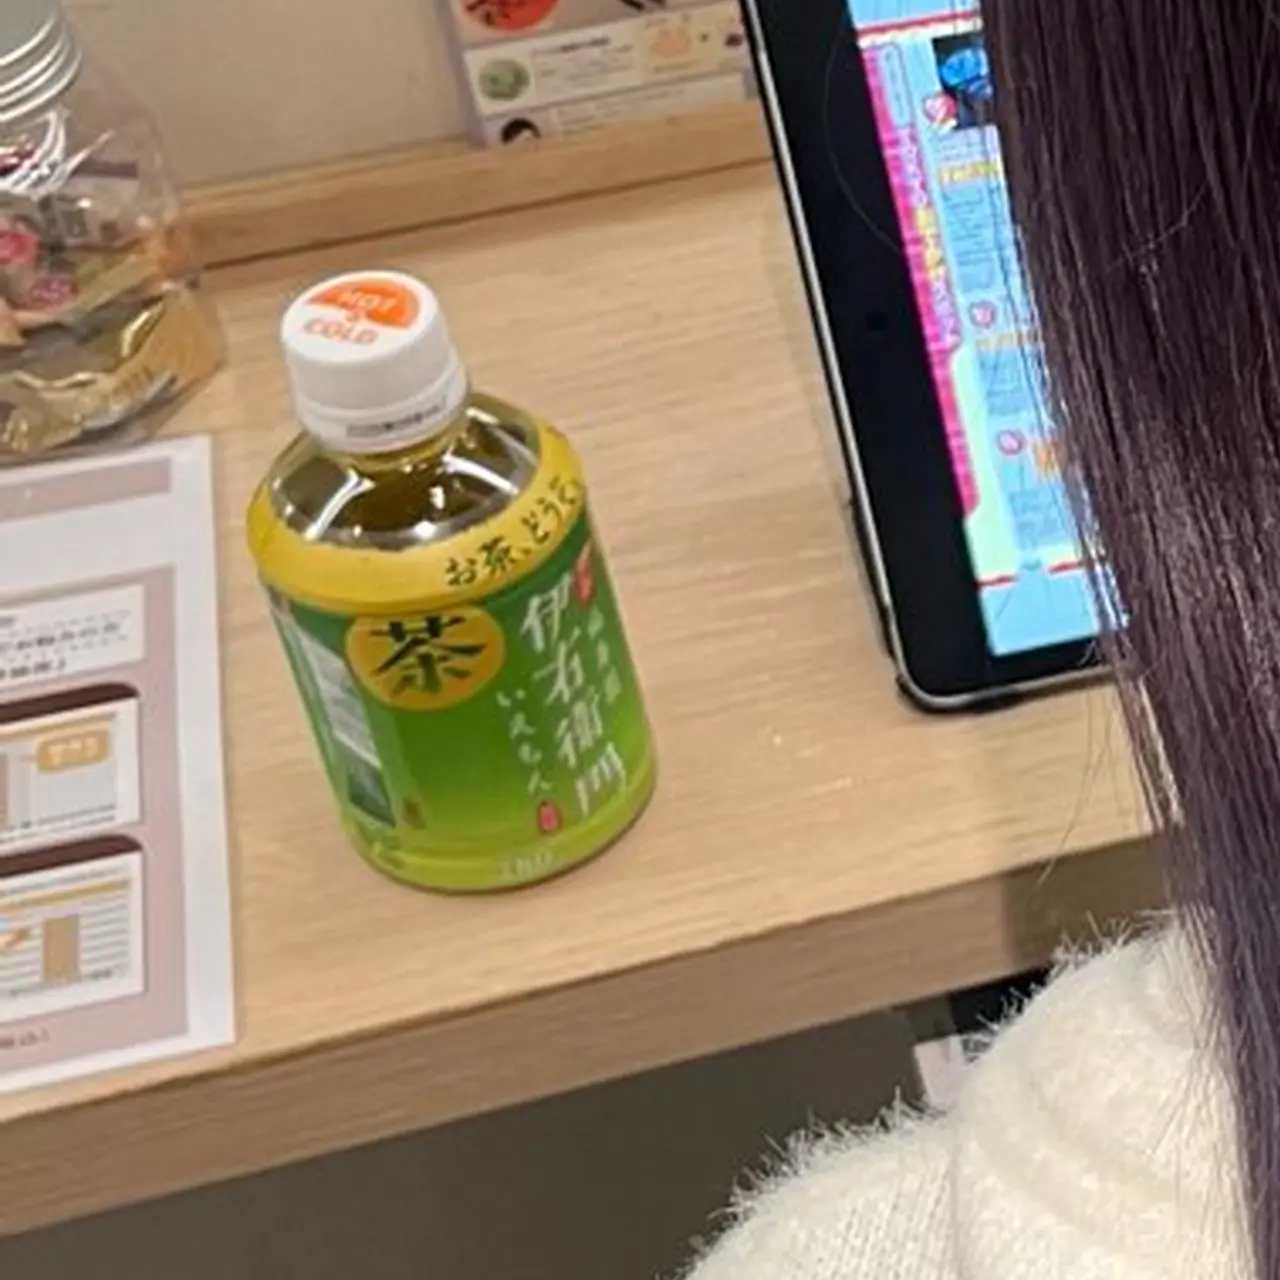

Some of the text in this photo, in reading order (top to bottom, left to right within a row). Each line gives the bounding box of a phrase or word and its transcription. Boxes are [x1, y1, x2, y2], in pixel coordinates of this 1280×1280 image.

[338, 290, 399, 312] HOT
[304, 318, 378, 345] COLD
[369, 614, 487, 696] 茶
[521, 572, 627, 817] 伊右衛門
